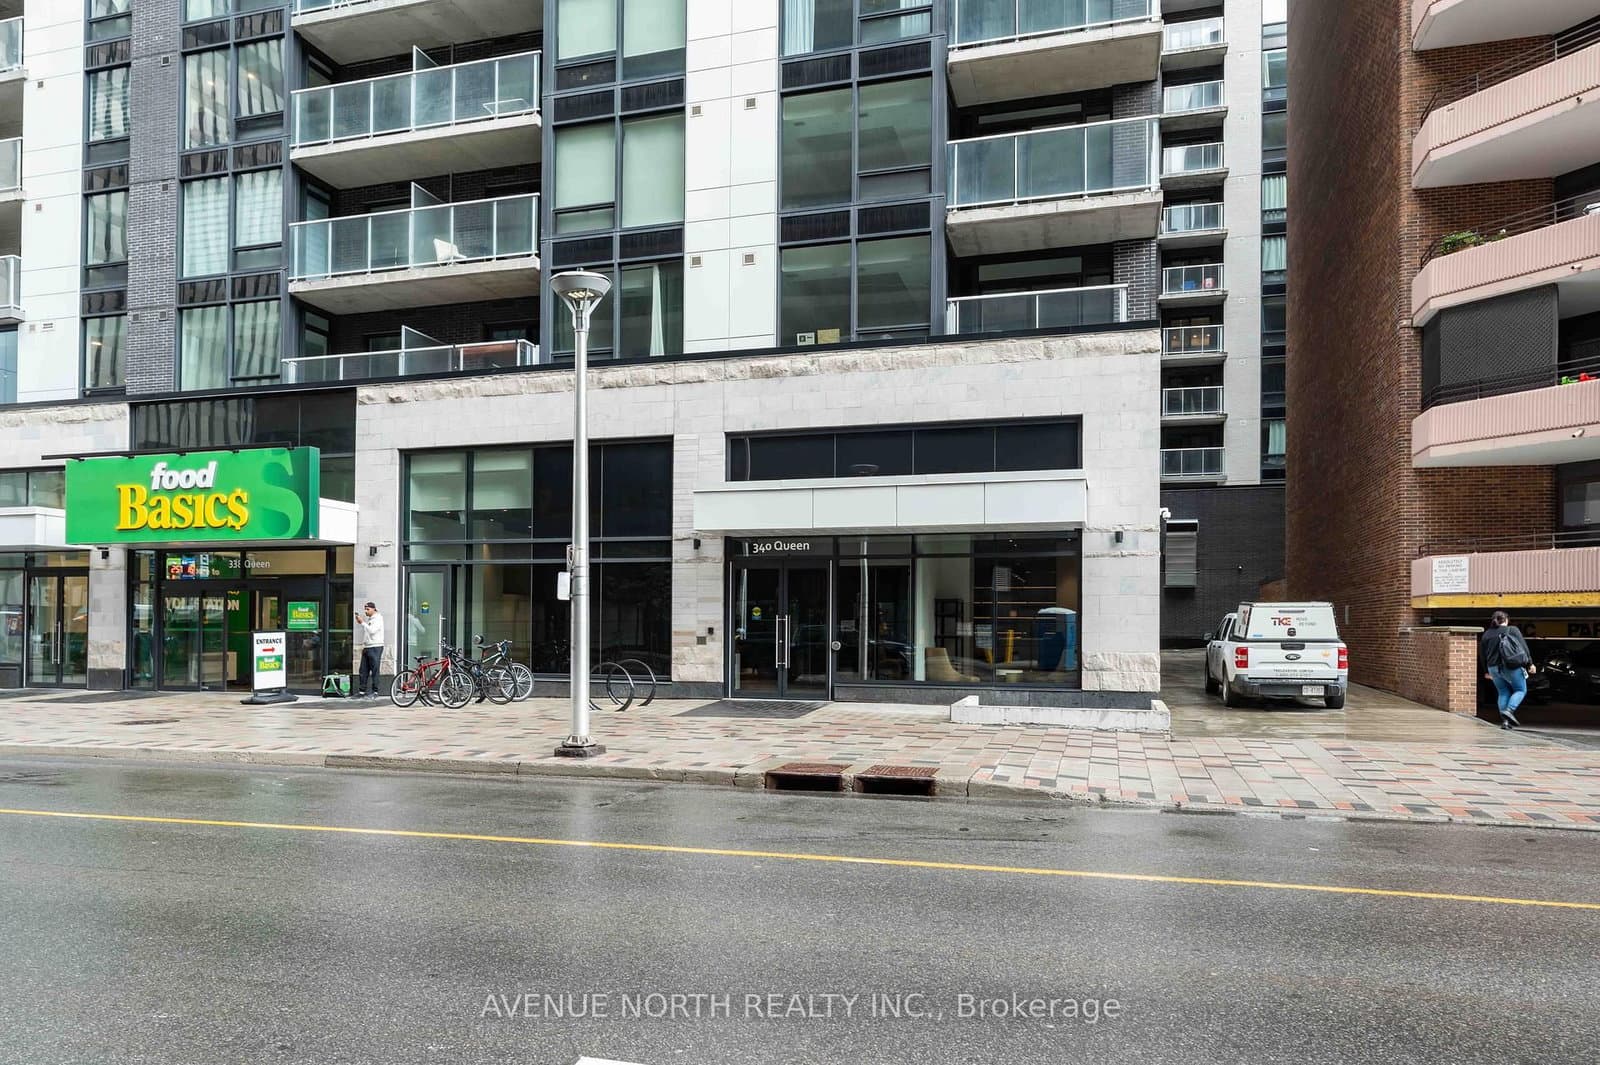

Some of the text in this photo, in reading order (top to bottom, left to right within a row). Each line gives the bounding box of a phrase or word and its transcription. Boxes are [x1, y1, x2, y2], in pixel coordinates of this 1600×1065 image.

[150, 460, 217, 490] food
[752, 540, 810, 554] 340 Queen
[244, 559, 271, 569] Queen
[255, 637, 282, 645] ENTRANCE
